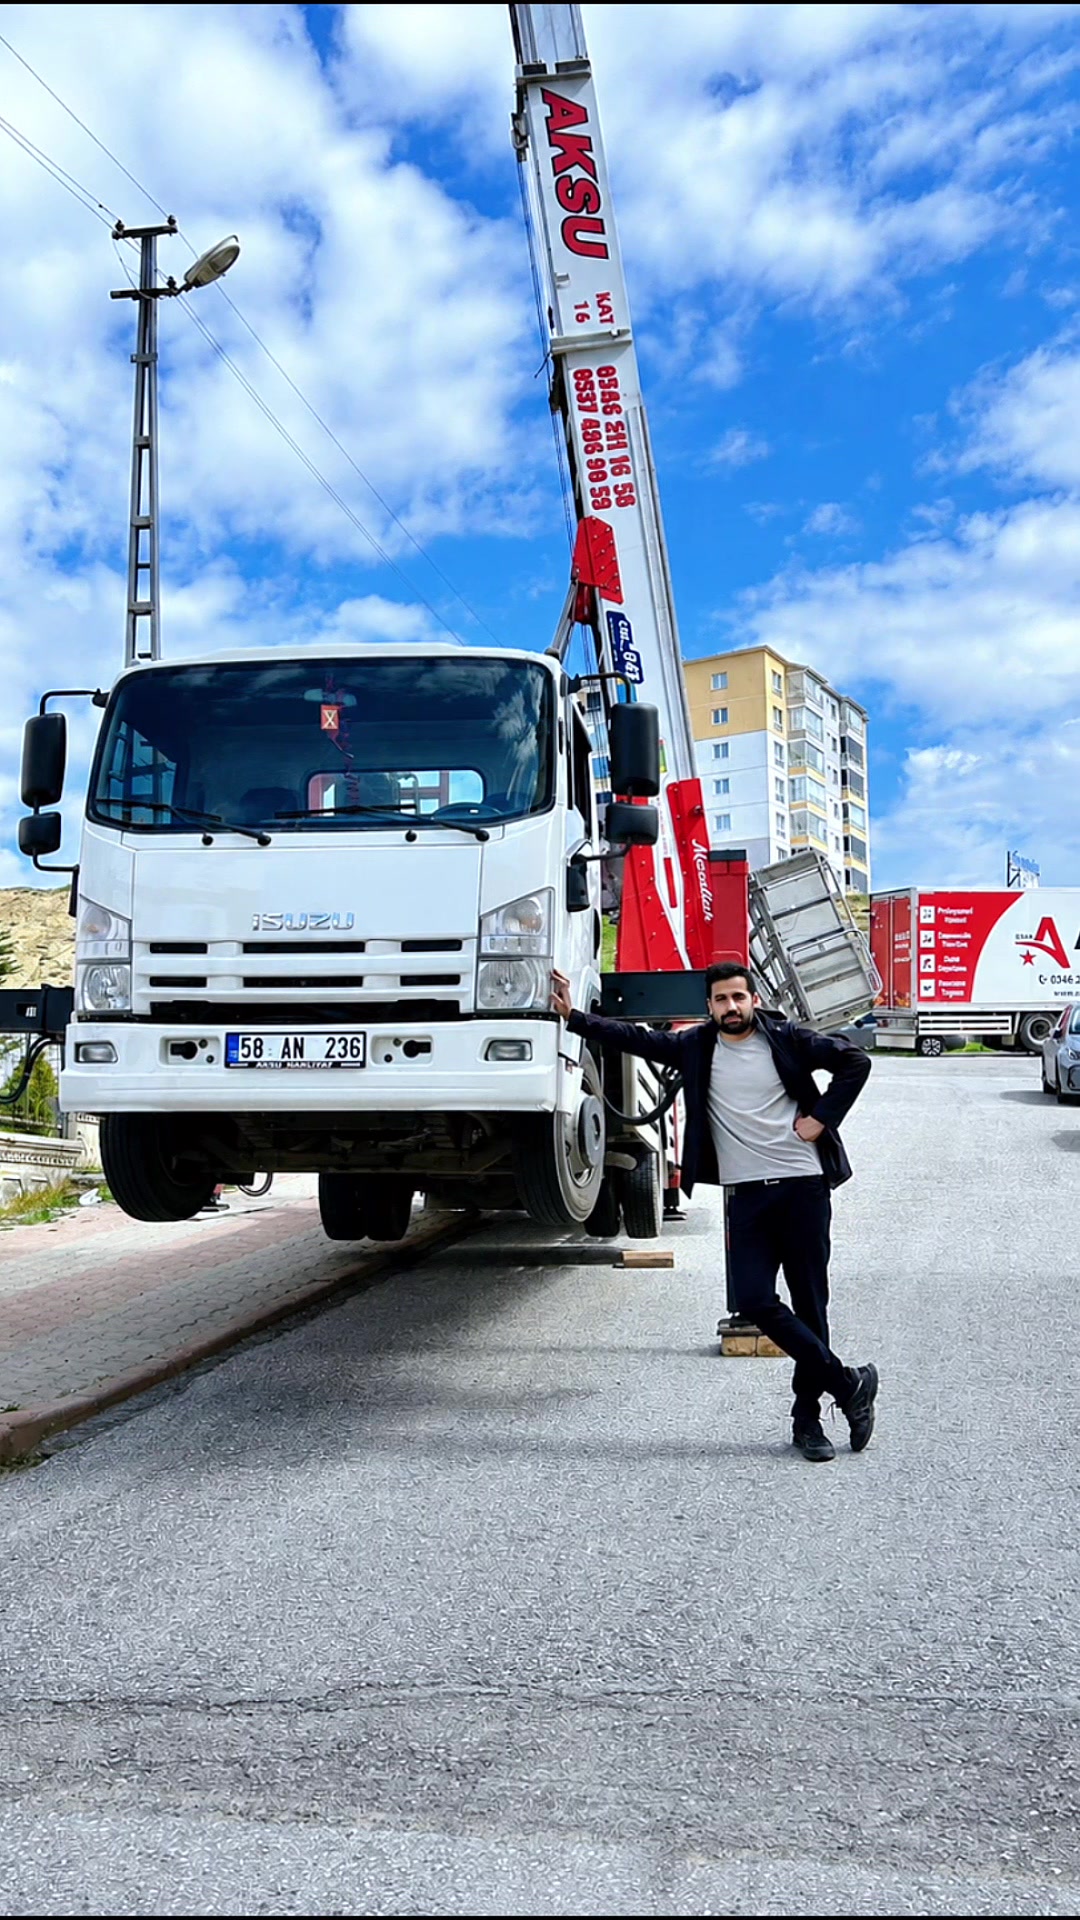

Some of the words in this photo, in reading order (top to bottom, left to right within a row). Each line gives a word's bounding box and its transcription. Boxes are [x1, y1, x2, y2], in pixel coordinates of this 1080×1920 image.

[540, 87, 609, 259] AKSU
[574, 301, 590, 324] 16
[595, 292, 615, 325] KAT
[573, 368, 599, 413] 0537
[581, 418, 604, 455] 496
[605, 420, 628, 451] 211
[586, 457, 609, 483] 90
[609, 455, 632, 477] 16
[590, 485, 612, 510] 59
[252, 912, 355, 932] ISUZU
[241, 1037, 264, 1060] 58
[281, 1037, 305, 1060] AN
[324, 1036, 361, 1060] 236
